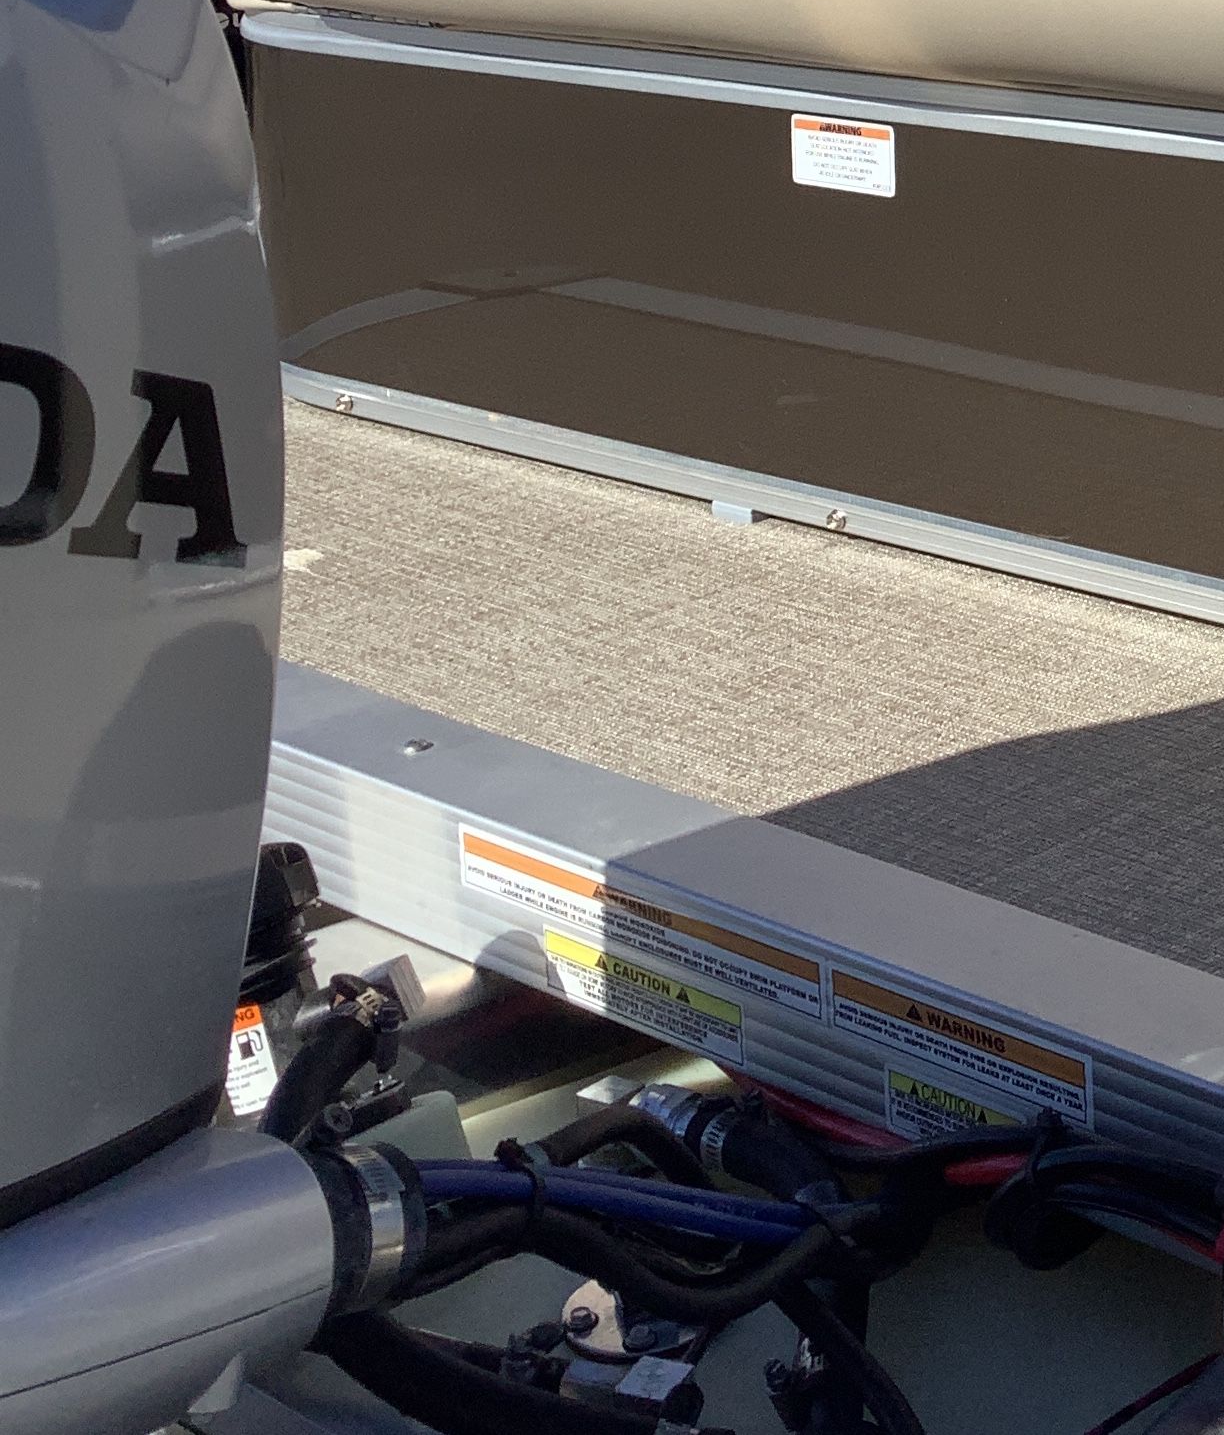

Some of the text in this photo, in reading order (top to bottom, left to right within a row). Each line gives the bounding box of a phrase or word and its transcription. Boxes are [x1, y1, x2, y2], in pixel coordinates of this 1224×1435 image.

[823, 122, 862, 137] WARNING
[603, 890, 672, 926] WARNING
[613, 962, 671, 997] CAUTION
[926, 1011, 1006, 1053] WARNING
[921, 1083, 976, 1118] CAUTION
